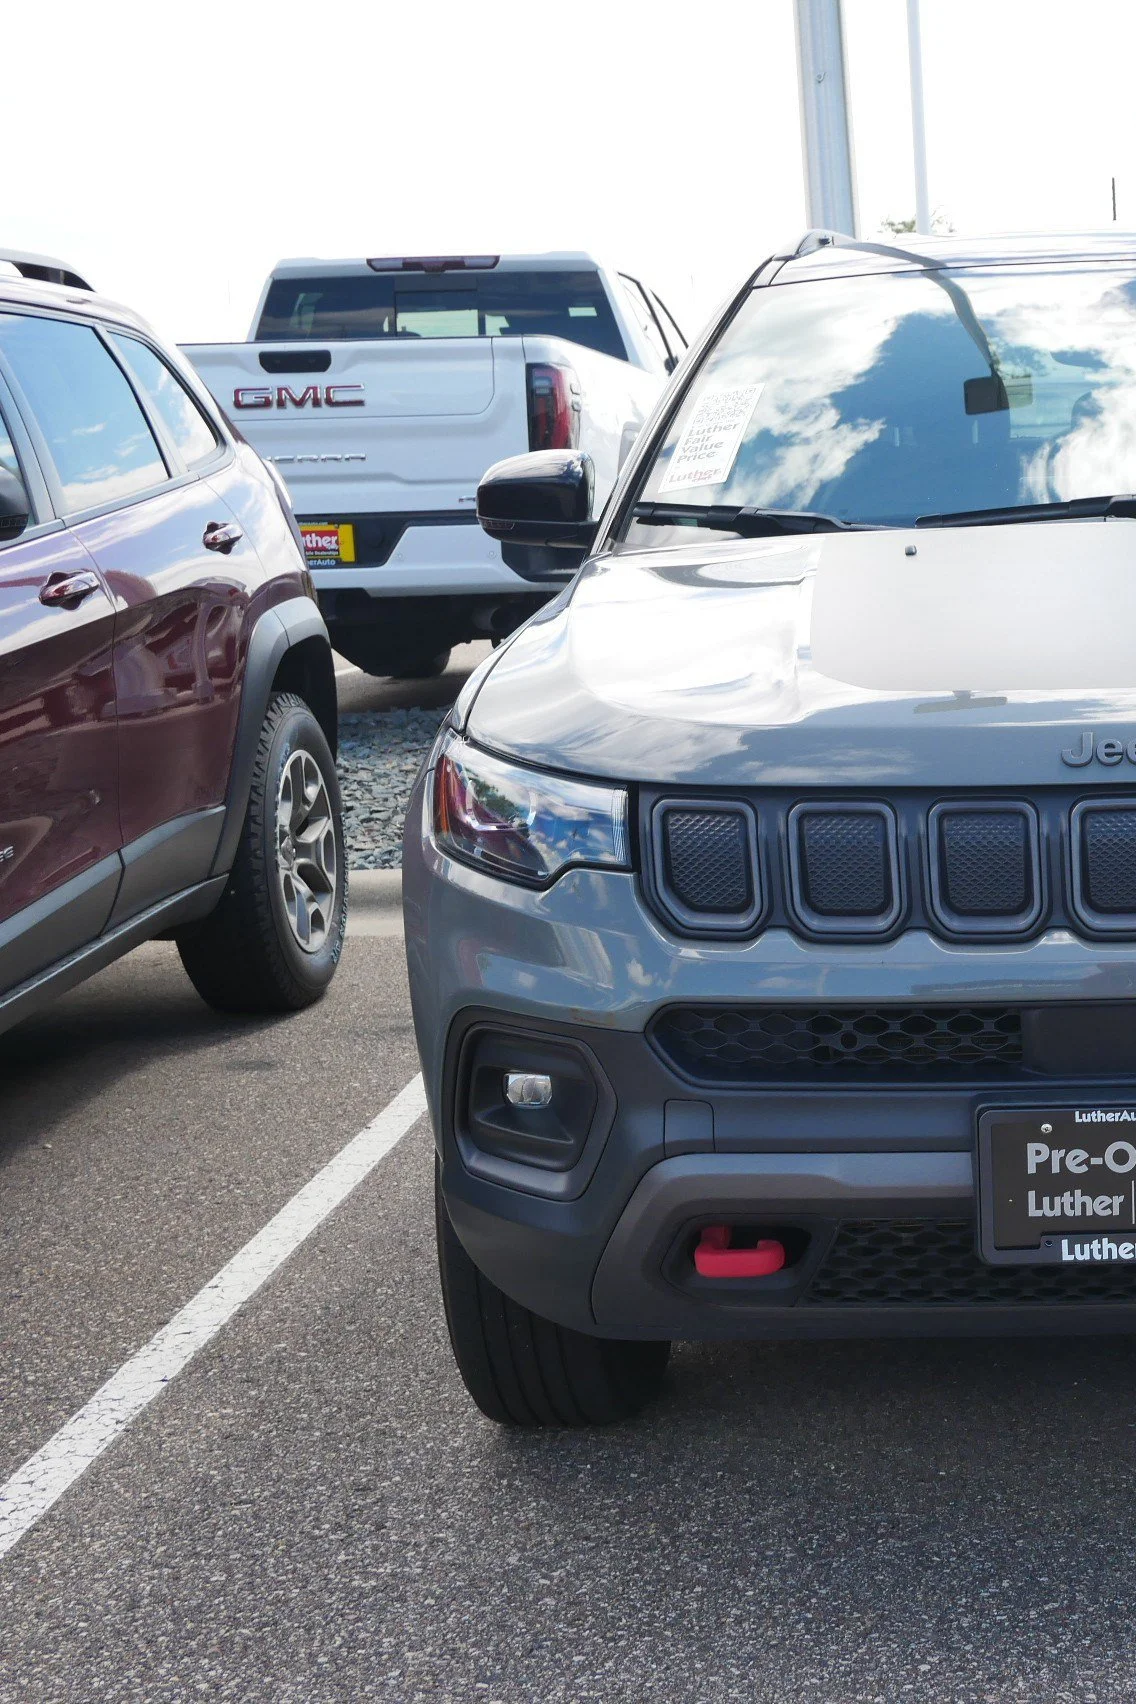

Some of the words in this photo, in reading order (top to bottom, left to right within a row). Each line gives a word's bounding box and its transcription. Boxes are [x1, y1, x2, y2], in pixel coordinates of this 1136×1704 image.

[233, 383, 365, 409] GMC
[687, 423, 740, 437] Luther
[682, 441, 724, 454] Value
[684, 435, 712, 446] Fair
[677, 452, 717, 464] Price
[302, 533, 338, 548] ther
[1028, 1190, 1125, 1217] Luther
